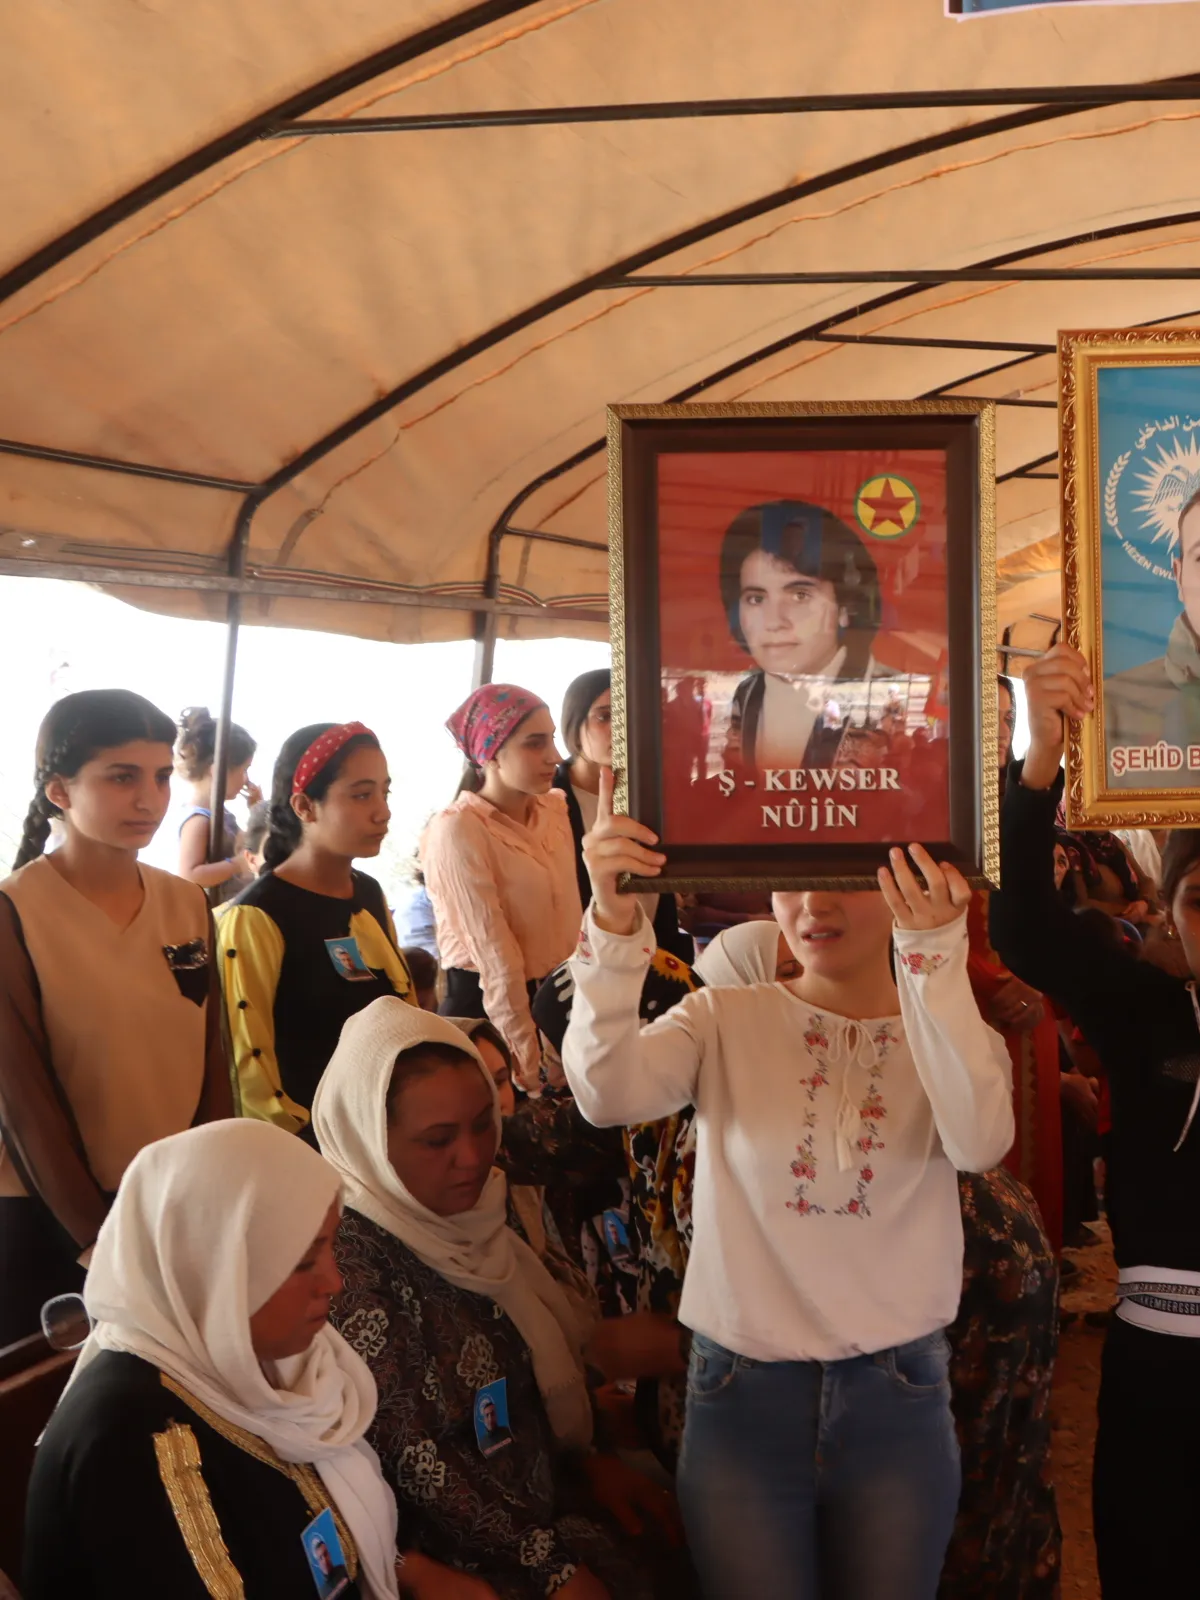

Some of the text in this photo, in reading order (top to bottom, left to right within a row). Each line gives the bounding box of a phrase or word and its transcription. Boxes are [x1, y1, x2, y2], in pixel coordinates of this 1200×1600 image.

[1111, 740, 1183, 776] ŞEHÎD
[718, 769, 737, 798] Ş
[763, 767, 902, 792] KEWSER
